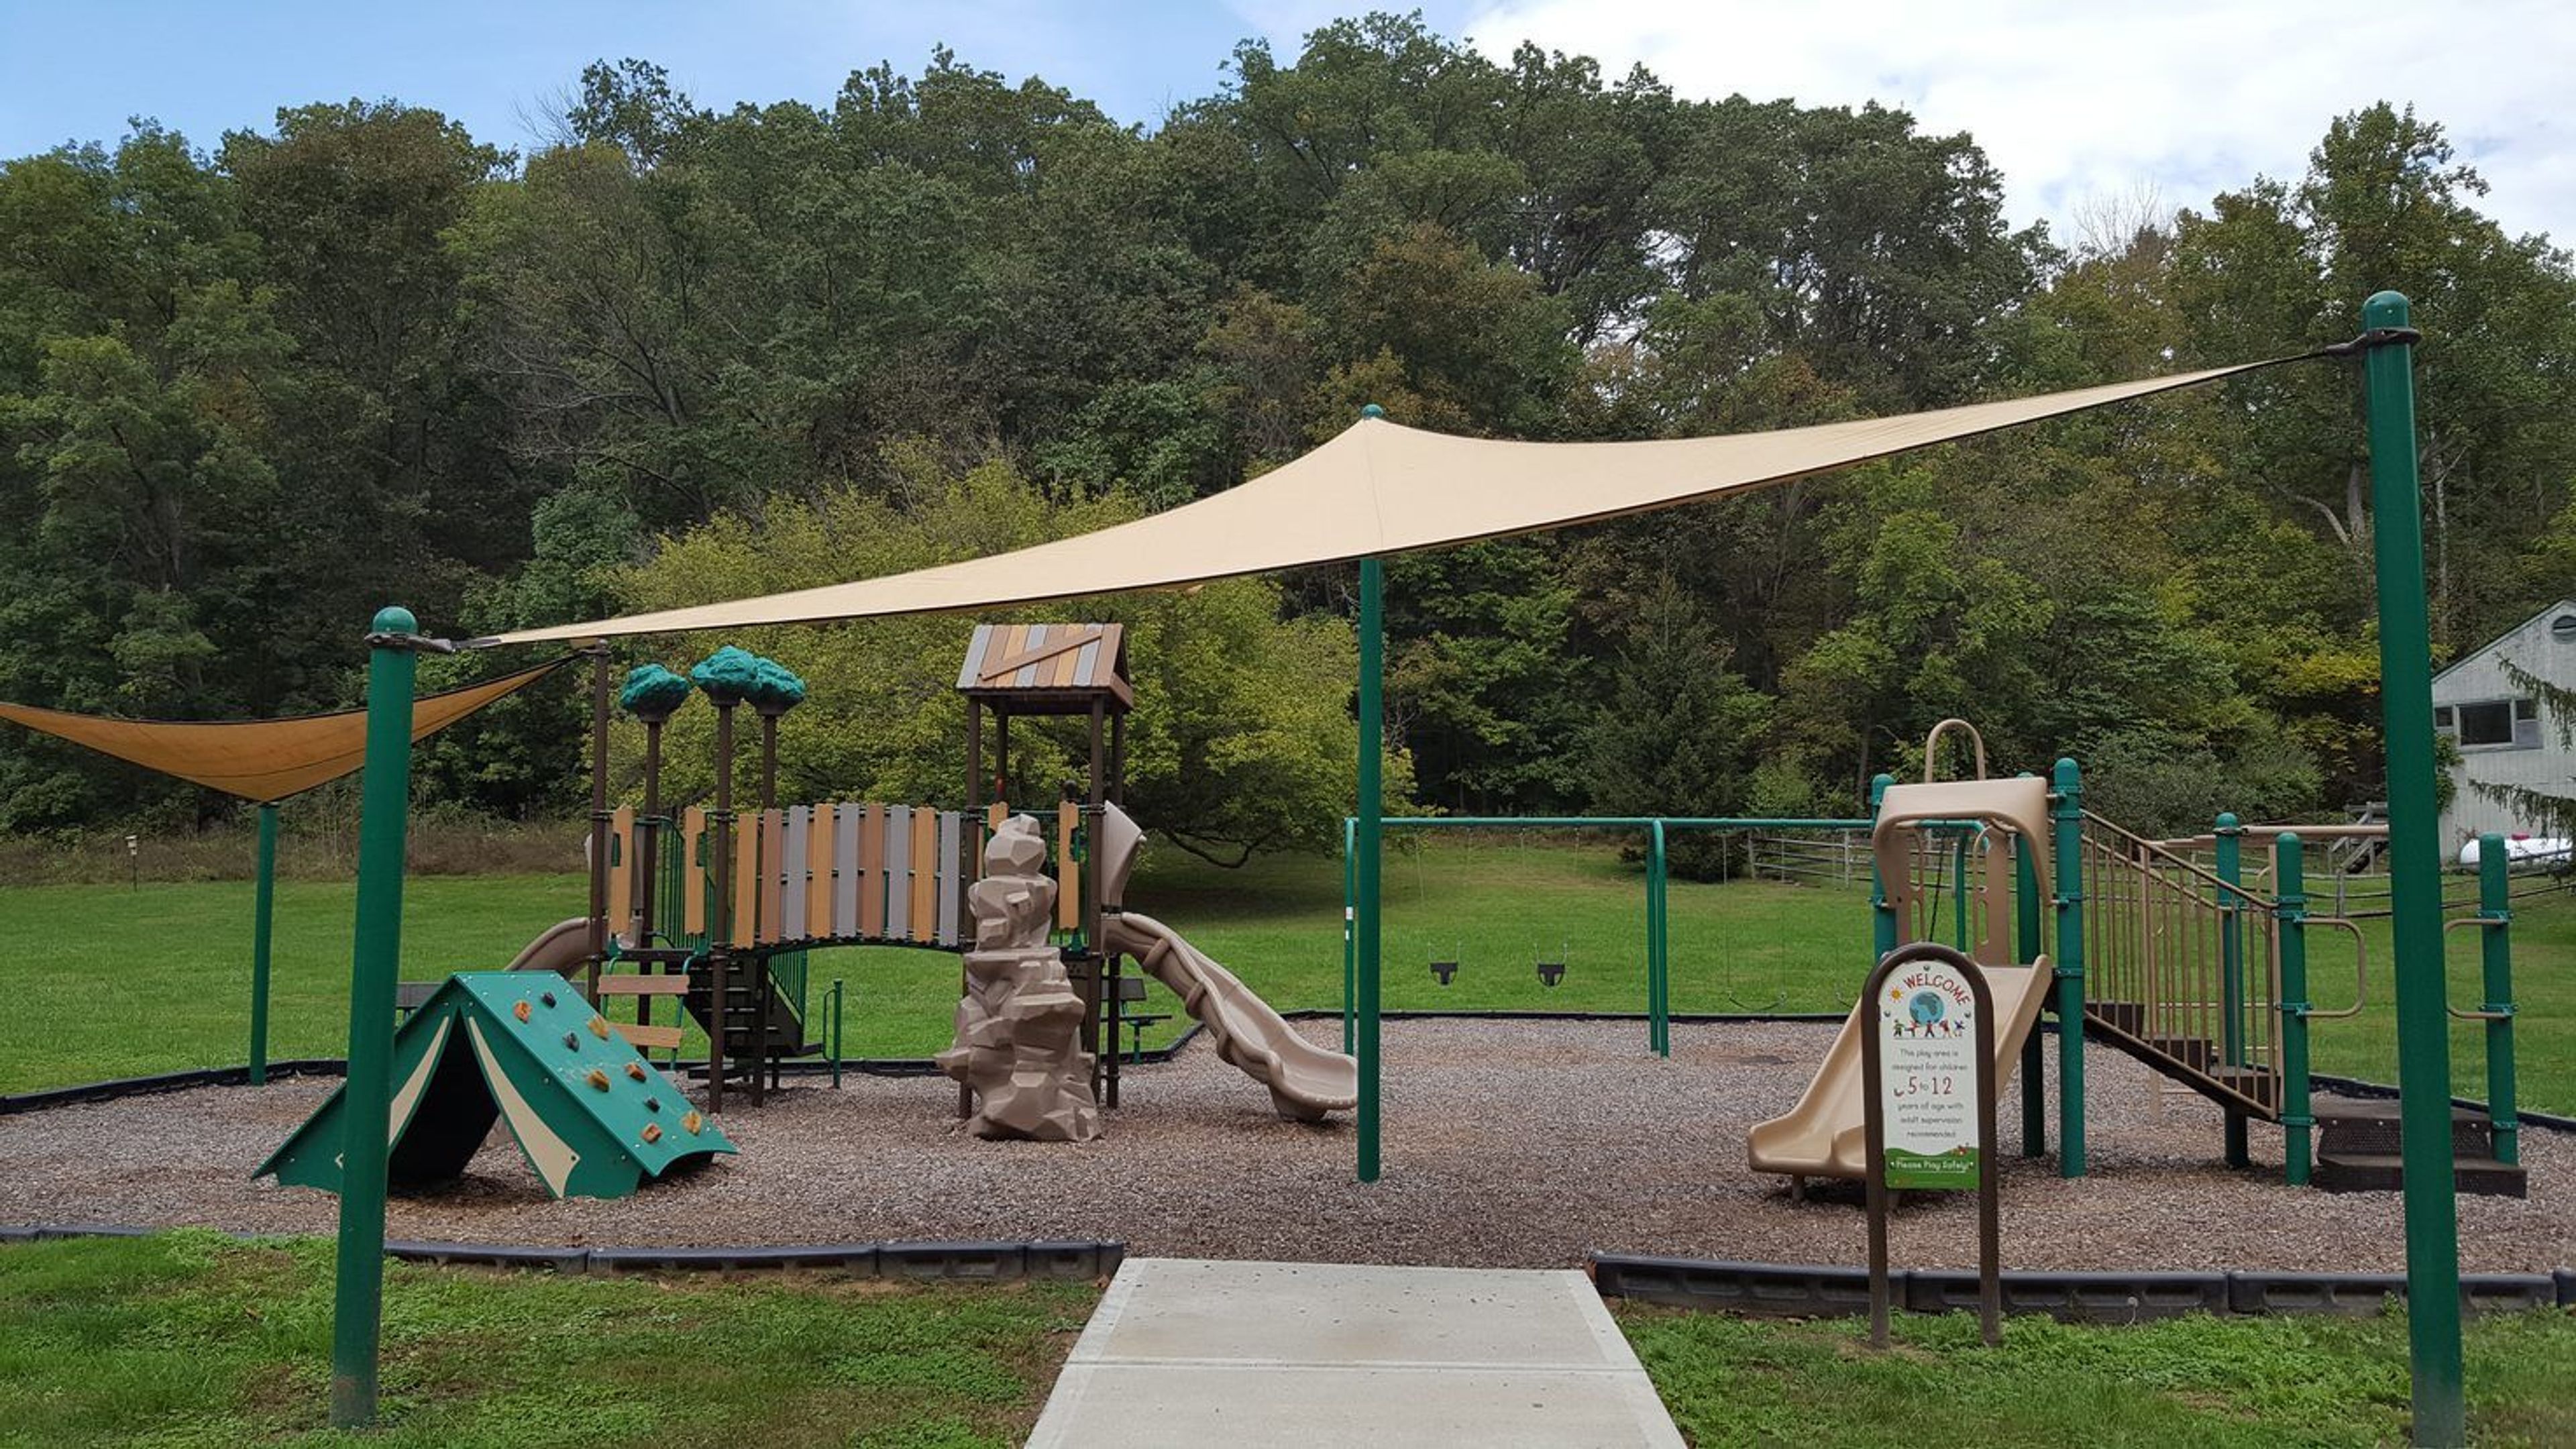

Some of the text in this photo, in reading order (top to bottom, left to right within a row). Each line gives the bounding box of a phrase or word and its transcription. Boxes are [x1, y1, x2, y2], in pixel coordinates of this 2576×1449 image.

[1903, 973, 1971, 1006] WELCOME
[1925, 1063, 1937, 1071] for
[1908, 1076, 1952, 1095] 5 to 12
